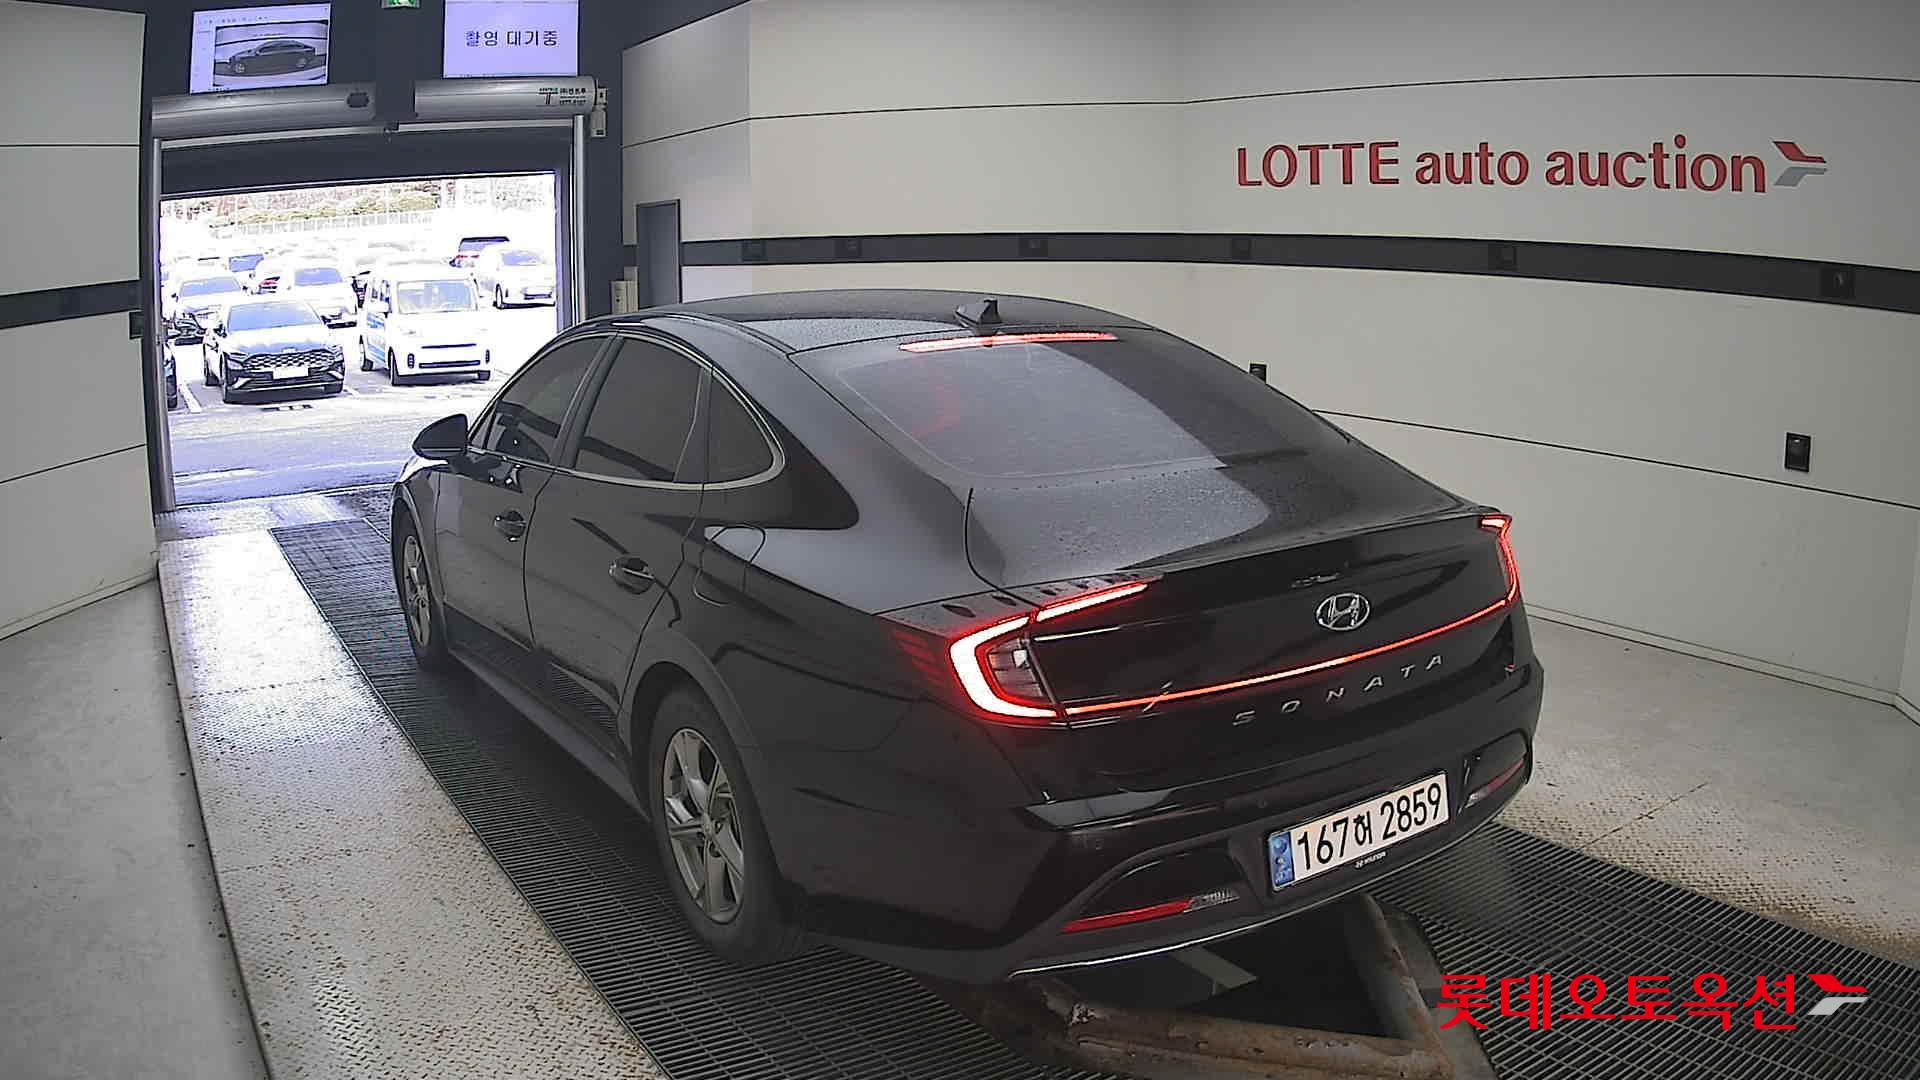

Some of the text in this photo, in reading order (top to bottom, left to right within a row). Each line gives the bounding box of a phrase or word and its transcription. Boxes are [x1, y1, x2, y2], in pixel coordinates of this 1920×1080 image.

[1237, 134, 1767, 194] LOTTE auto auction
[1232, 655, 1443, 727] SONATA
[1297, 782, 1442, 871] 167허 2859
